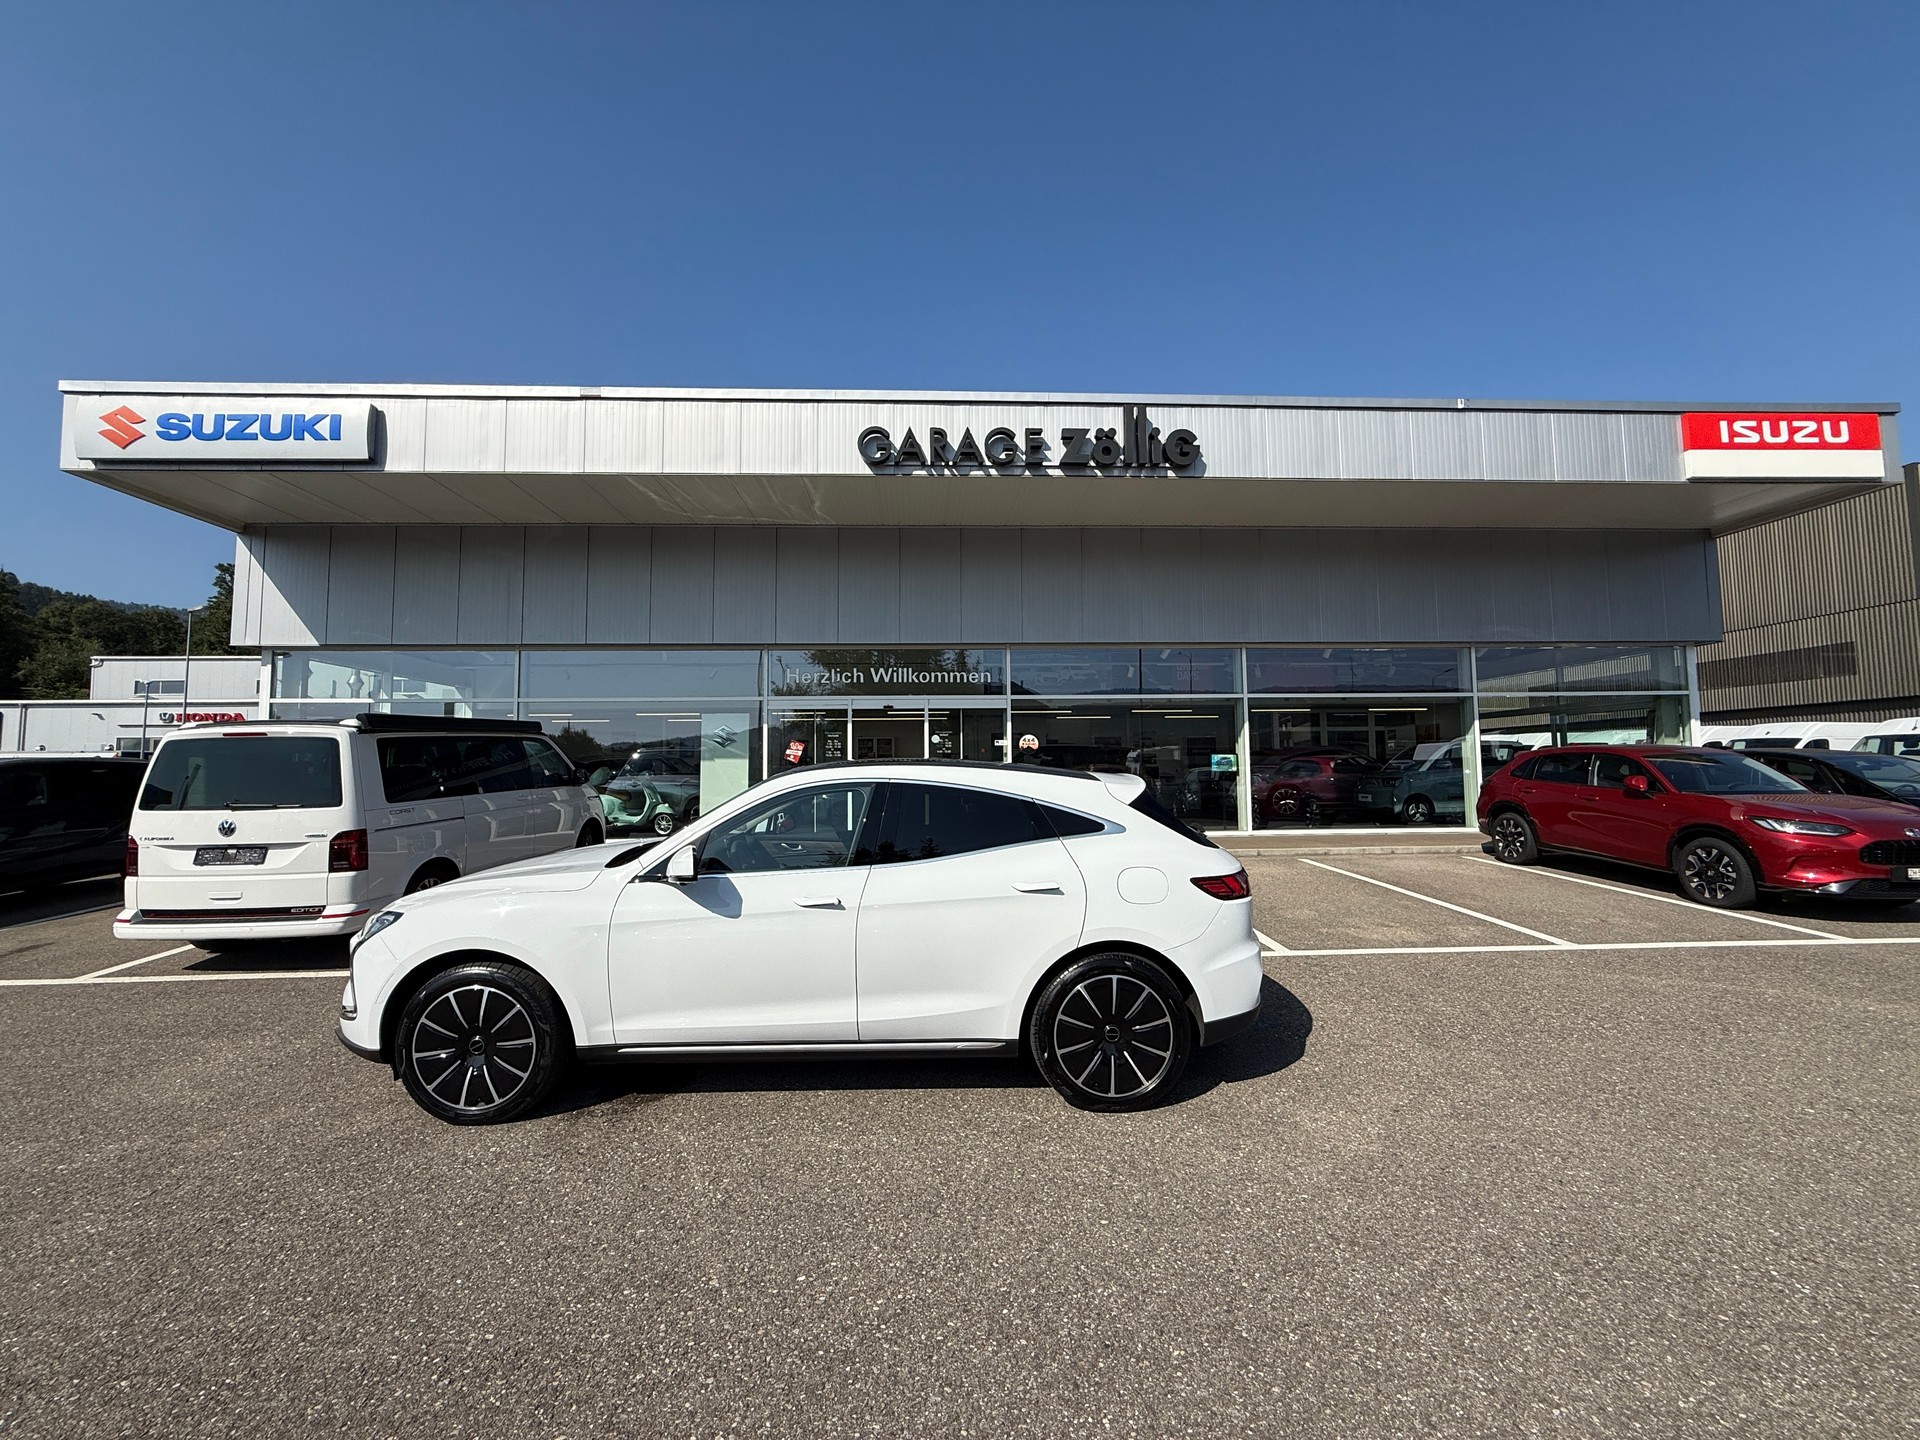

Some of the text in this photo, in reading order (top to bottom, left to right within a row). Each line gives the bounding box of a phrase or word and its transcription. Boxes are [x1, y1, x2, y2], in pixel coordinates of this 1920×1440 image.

[155, 412, 342, 441] SUZUKI
[1719, 420, 1849, 443] ISUZU
[857, 425, 1044, 465] GARAGE
[786, 667, 991, 684] Herzlich Willkommen
[175, 712, 246, 723] HONDA
